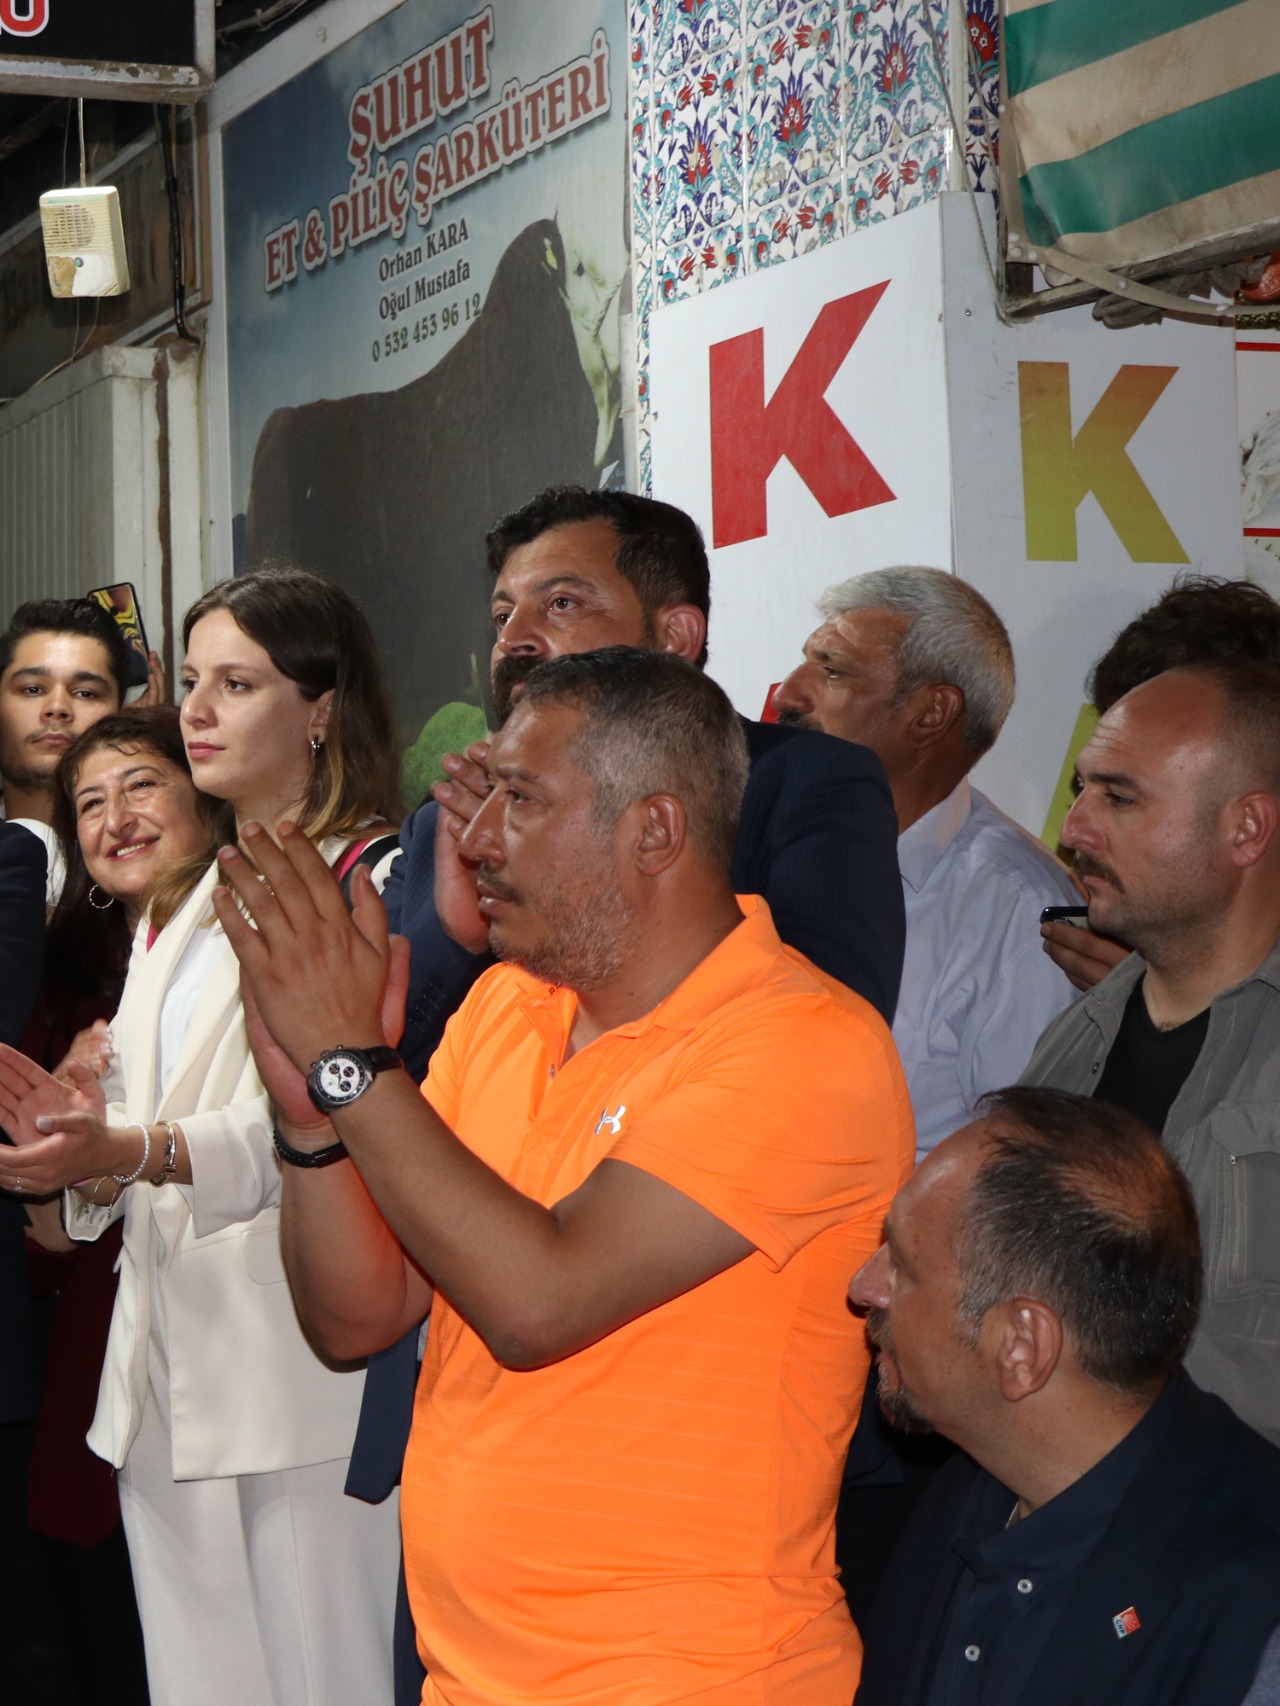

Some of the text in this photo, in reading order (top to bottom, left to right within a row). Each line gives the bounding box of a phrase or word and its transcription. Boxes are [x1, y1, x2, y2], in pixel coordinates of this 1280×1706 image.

[349, 14, 493, 176] ŞUHUT
[266, 37, 609, 286] ET & PİLİÇ ŞARKÜTERİ
[379, 218, 469, 282] Orhan KARA
[379, 261, 471, 321] Oğul Mustafa
[372, 292, 482, 362] 0 532 453 96 12
